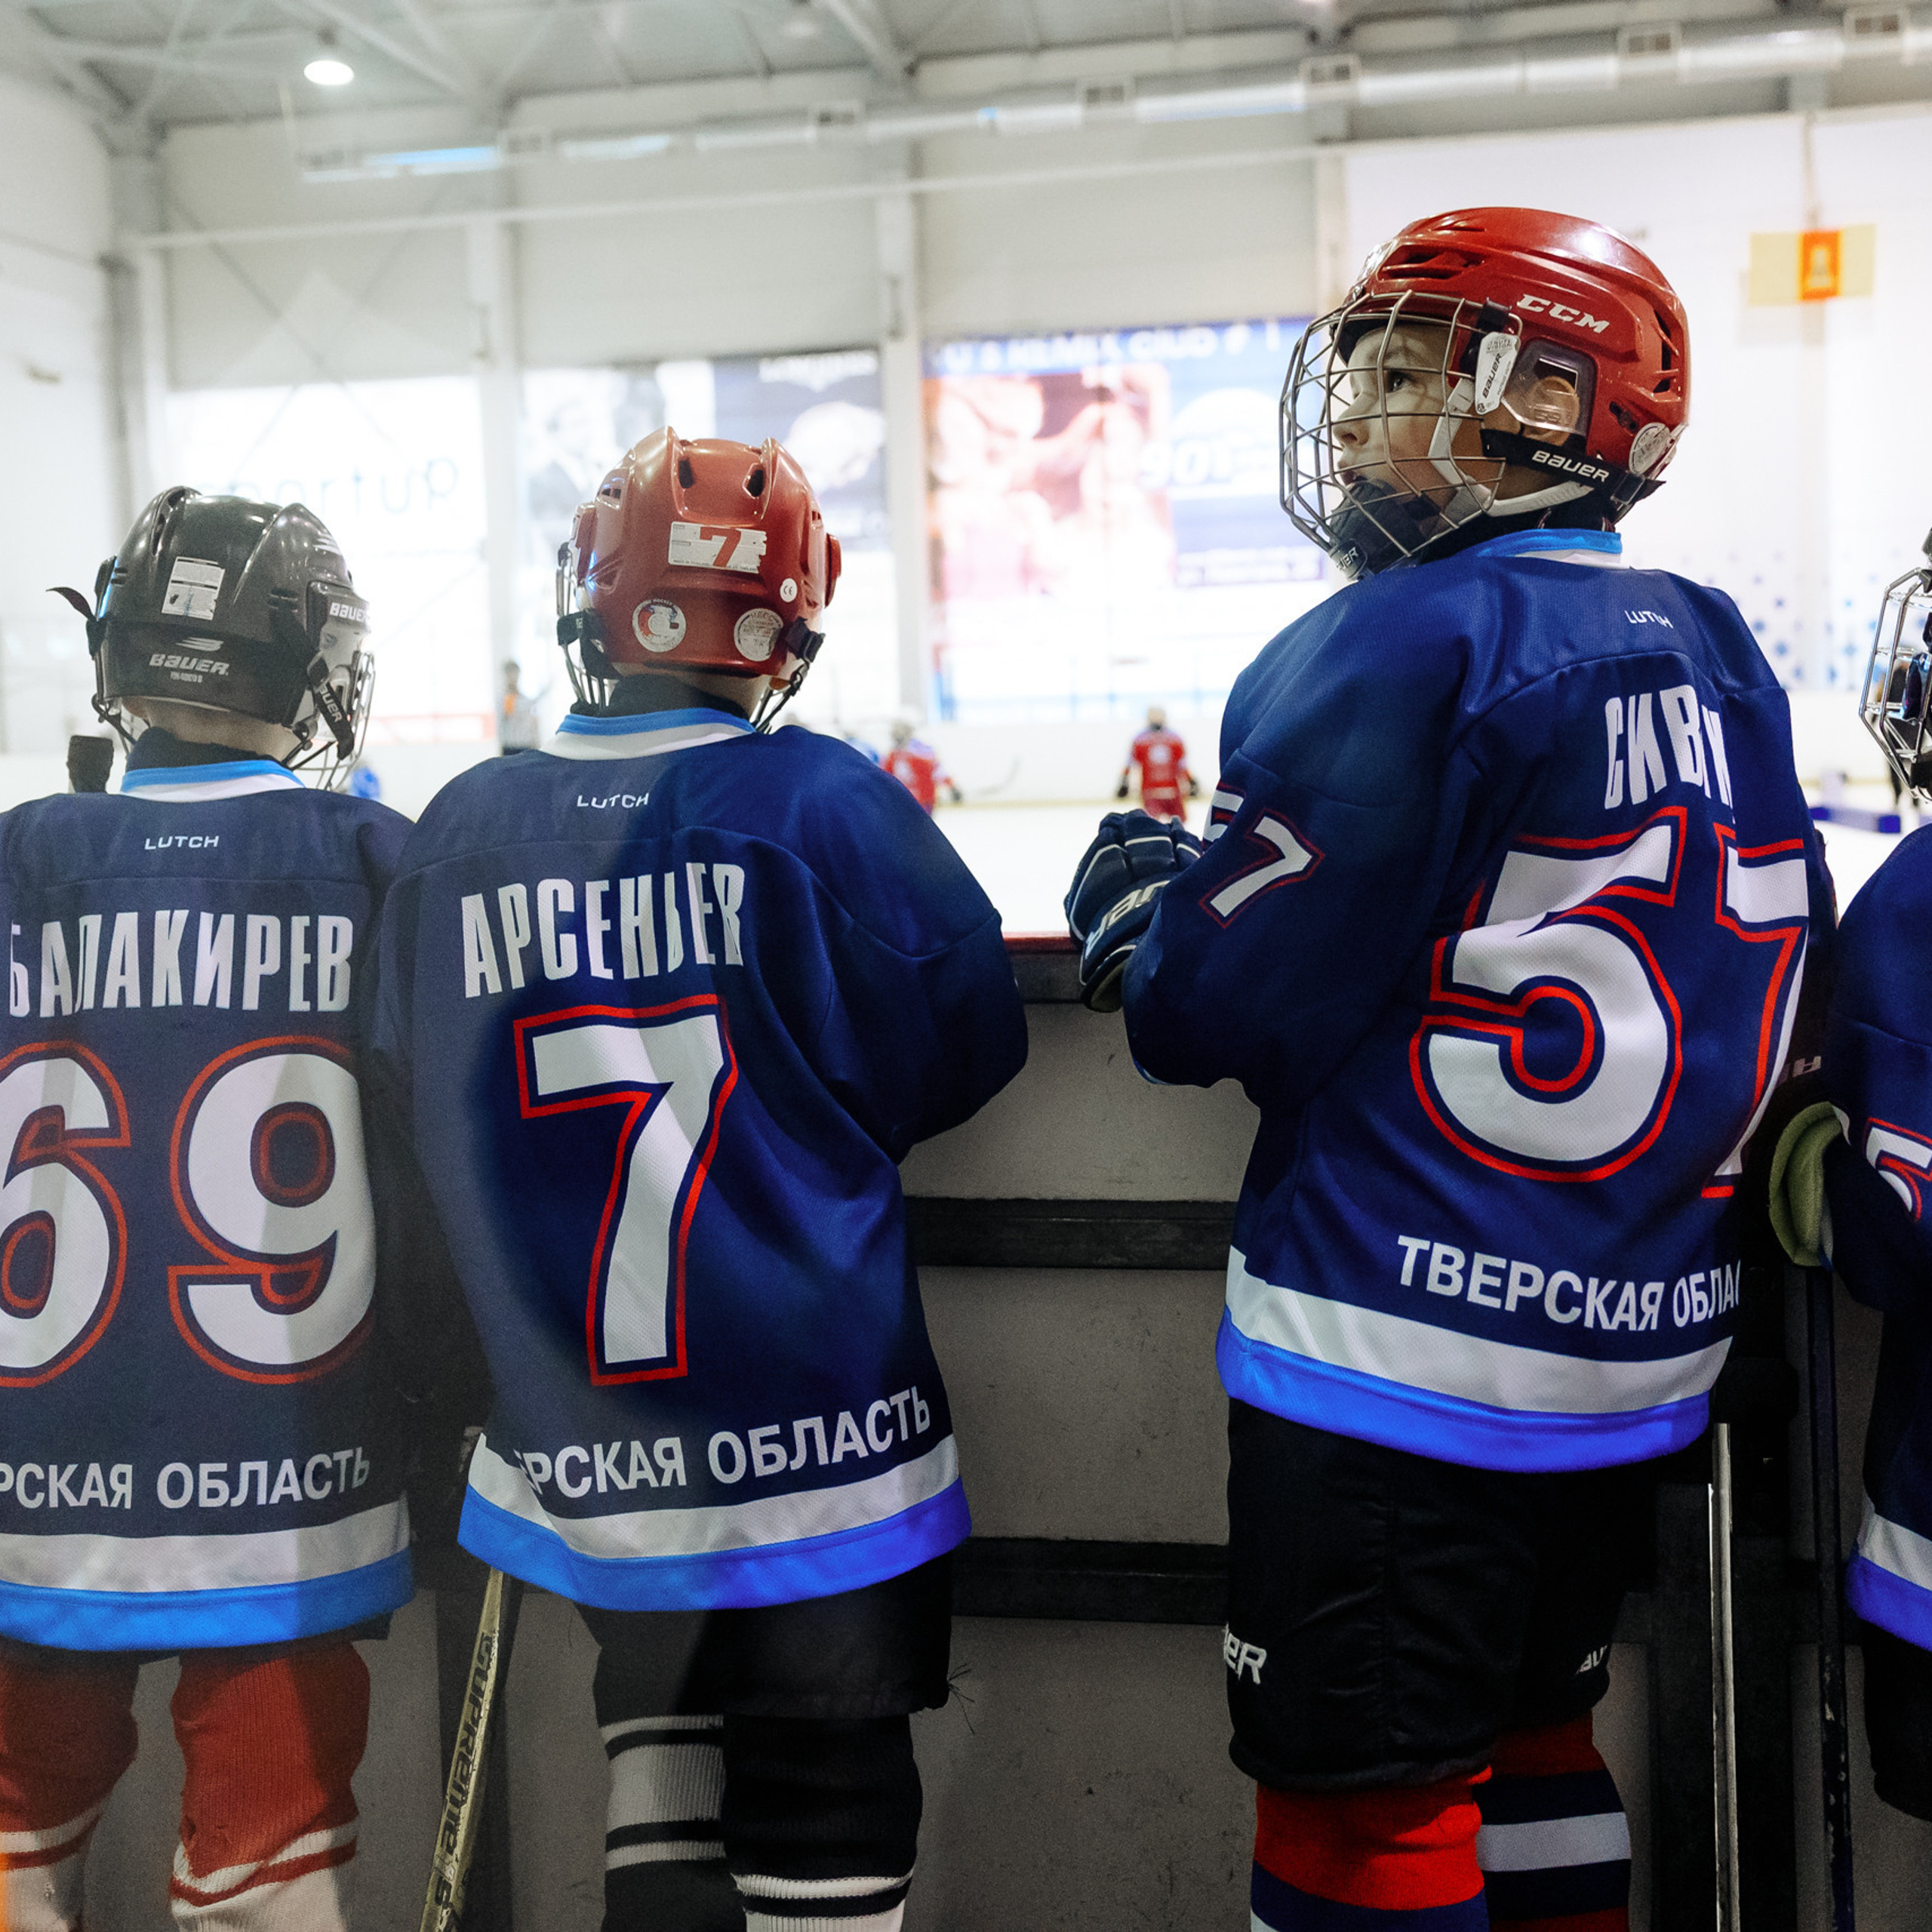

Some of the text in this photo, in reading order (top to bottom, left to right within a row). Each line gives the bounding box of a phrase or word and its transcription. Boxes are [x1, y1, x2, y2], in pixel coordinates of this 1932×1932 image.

[1516, 294, 1610, 334] CCM
[1532, 450, 1610, 482] BAUER
[699, 526, 742, 568] 7
[149, 654, 230, 676] BAUER
[577, 792, 650, 809] LUTCH
[144, 835, 220, 851] LUTCH
[9, 909, 353, 1018] БАЛАКИРЕВ
[513, 993, 738, 1386] 7
[1398, 1235, 1741, 1331] ТВЕРСКАЯ ОБЛА
[708, 1386, 931, 1484] ОБЛАСТЬ
[156, 1446, 371, 1509] ОБЛАСТЬ
